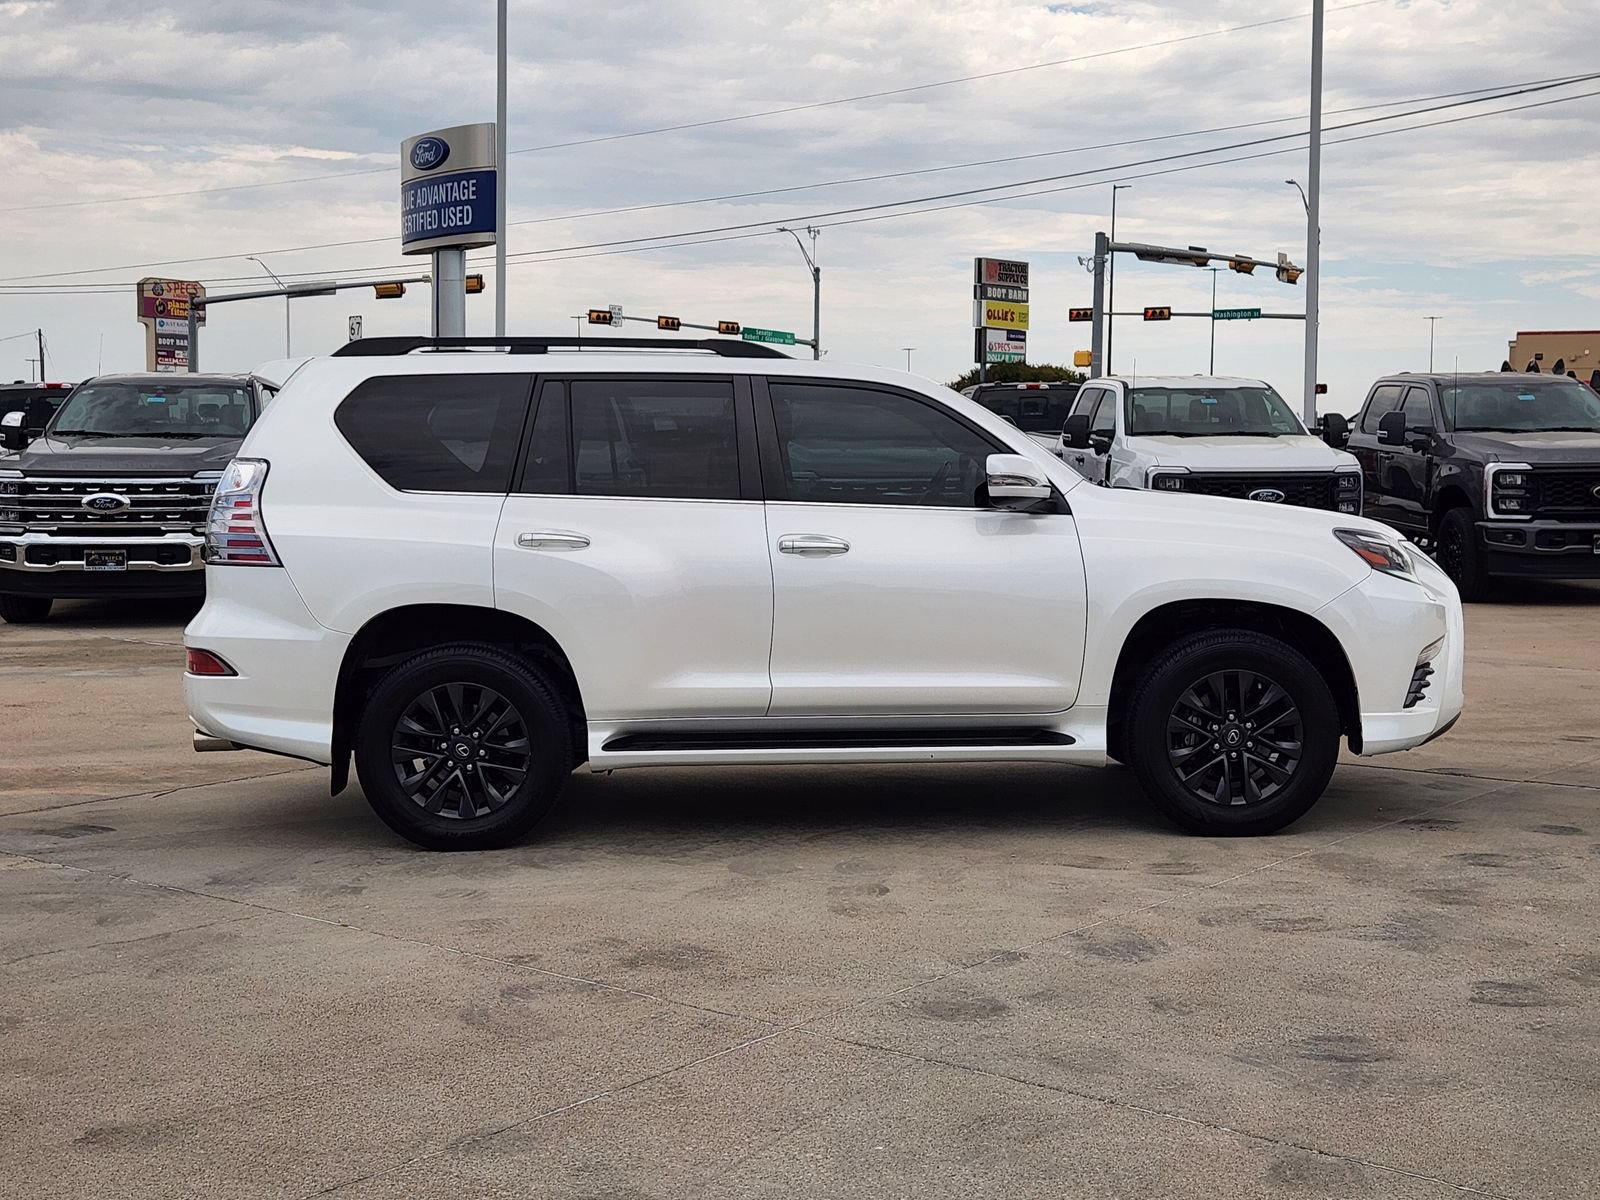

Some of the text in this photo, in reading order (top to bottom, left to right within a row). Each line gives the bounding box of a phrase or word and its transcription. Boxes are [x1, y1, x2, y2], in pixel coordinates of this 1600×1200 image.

[415, 143, 435, 164] Ford
[416, 180, 476, 208] ADVANTAGE
[441, 205, 472, 228] USED
[998, 262, 1027, 274] TRACTOR
[998, 272, 1020, 283] SUPPLY
[987, 287, 1028, 301] BOOT BARN
[167, 300, 189, 310] plane
[986, 308, 1015, 322] OLLIE'S
[1214, 311, 1252, 319] Washington
[351, 322, 360, 336] 67
[158, 357, 189, 365] CINEMAR
[1258, 492, 1276, 501] Ford
[94, 499, 116, 508] Ford
